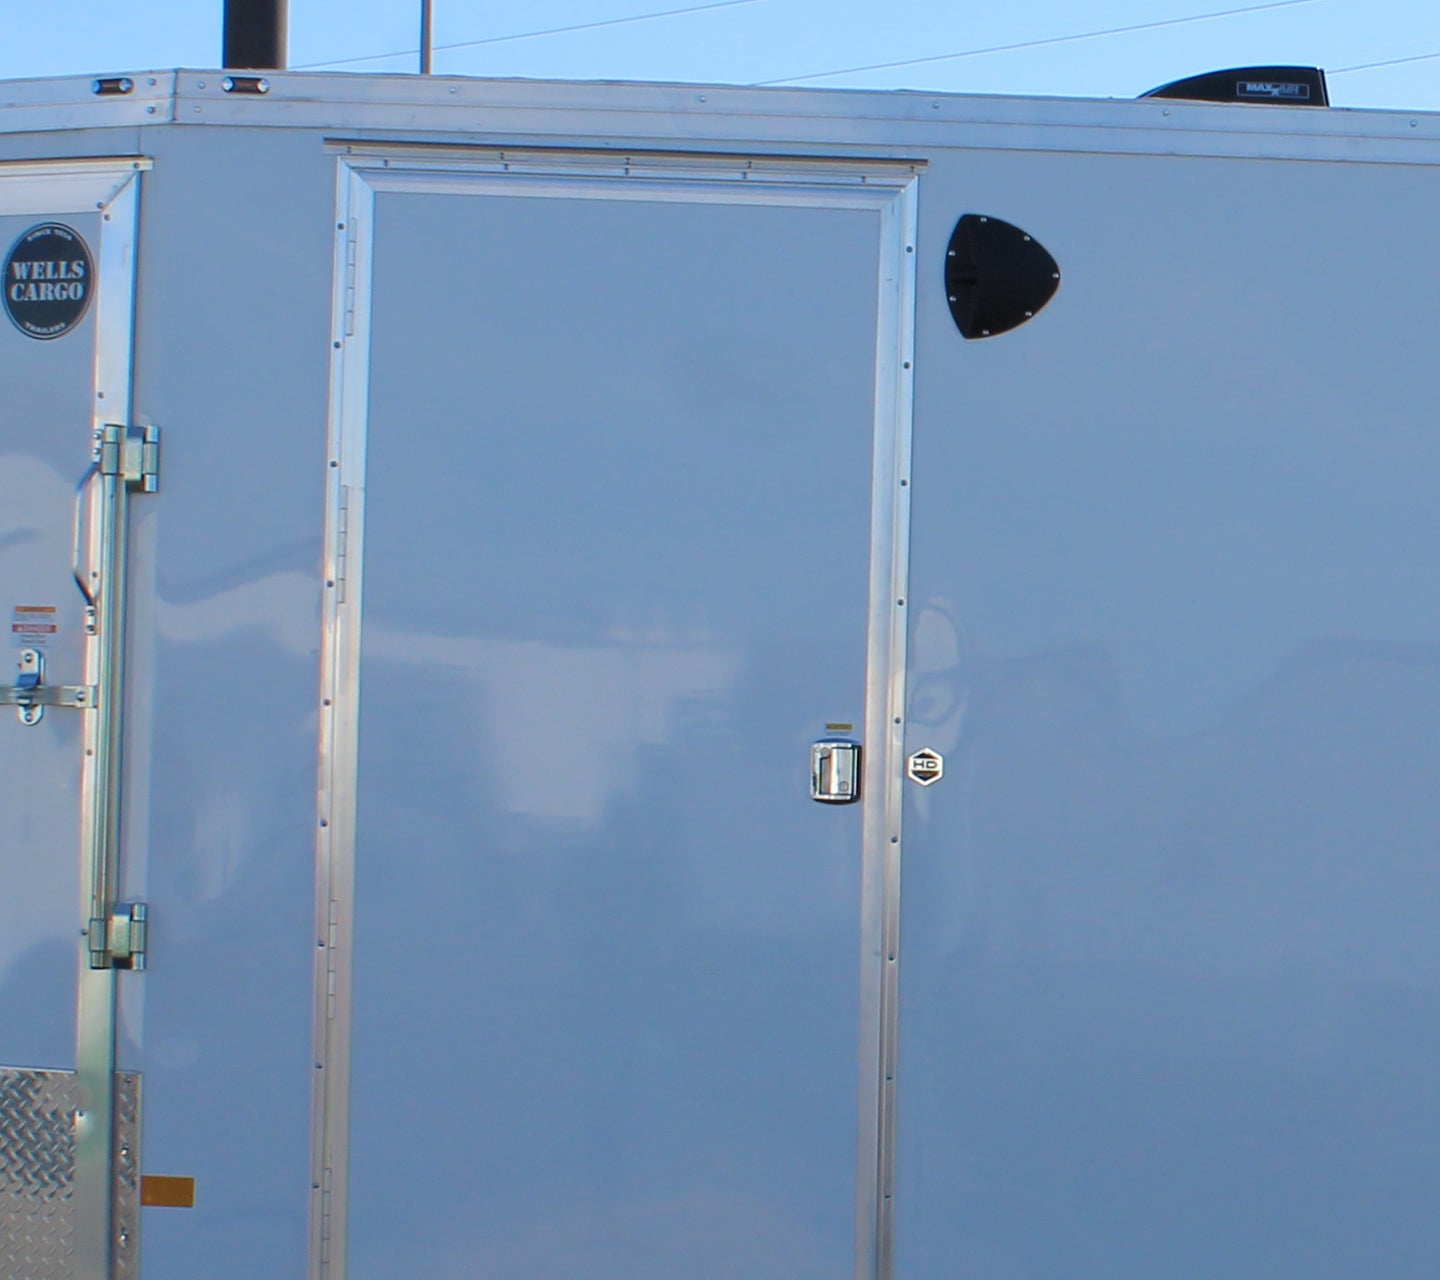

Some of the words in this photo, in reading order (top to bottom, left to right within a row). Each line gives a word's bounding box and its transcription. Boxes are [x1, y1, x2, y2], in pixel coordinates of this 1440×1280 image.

[12, 261, 85, 279] WELLS
[11, 282, 84, 301] CARGO
[913, 760, 938, 769] HD
